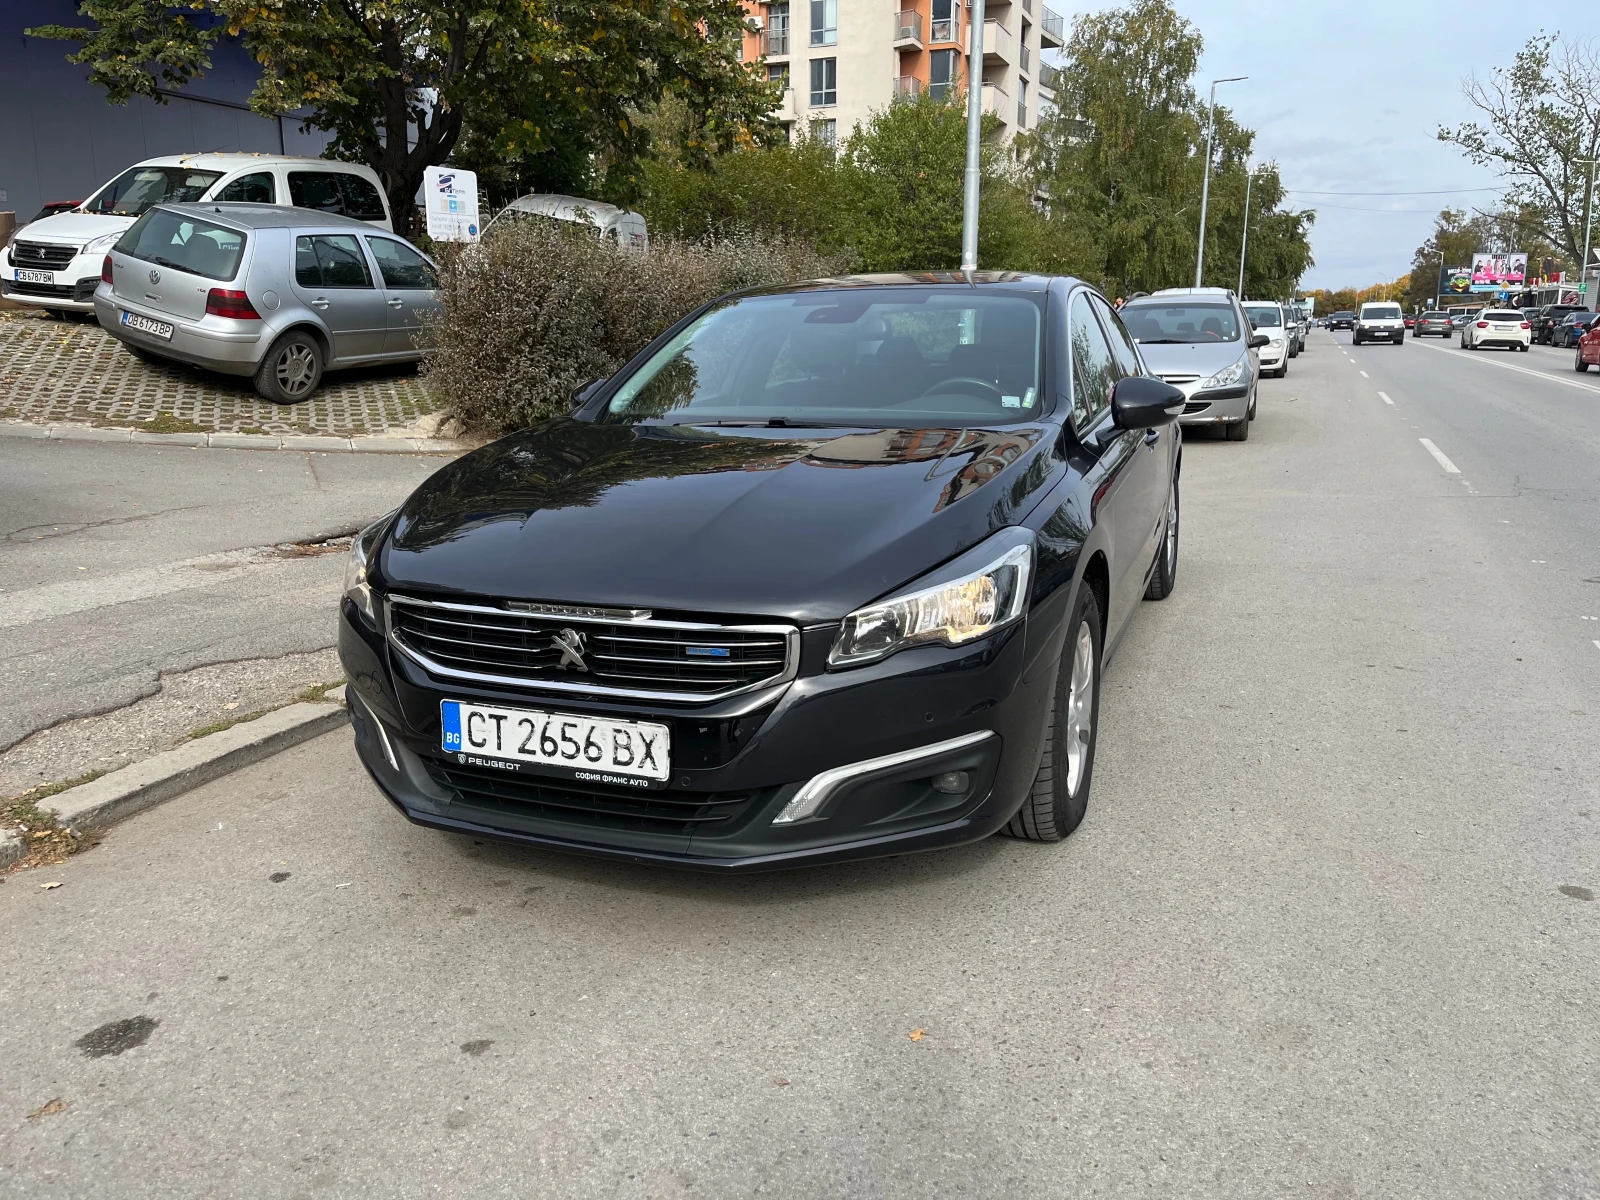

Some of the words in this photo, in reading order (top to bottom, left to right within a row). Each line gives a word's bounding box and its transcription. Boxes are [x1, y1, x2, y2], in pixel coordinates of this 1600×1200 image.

[28, 272, 42, 281] 6787
[139, 318, 159, 333] 6173
[159, 324, 171, 335] BP
[446, 732, 460, 744] BG
[468, 711, 508, 751] CT
[517, 715, 603, 763] 2656
[612, 727, 659, 771] BX
[468, 757, 521, 771] PEUGEOT
[575, 771, 601, 781] СОФИЯ
[602, 774, 628, 785] ФРАНС
[629, 779, 648, 787] АУТО
